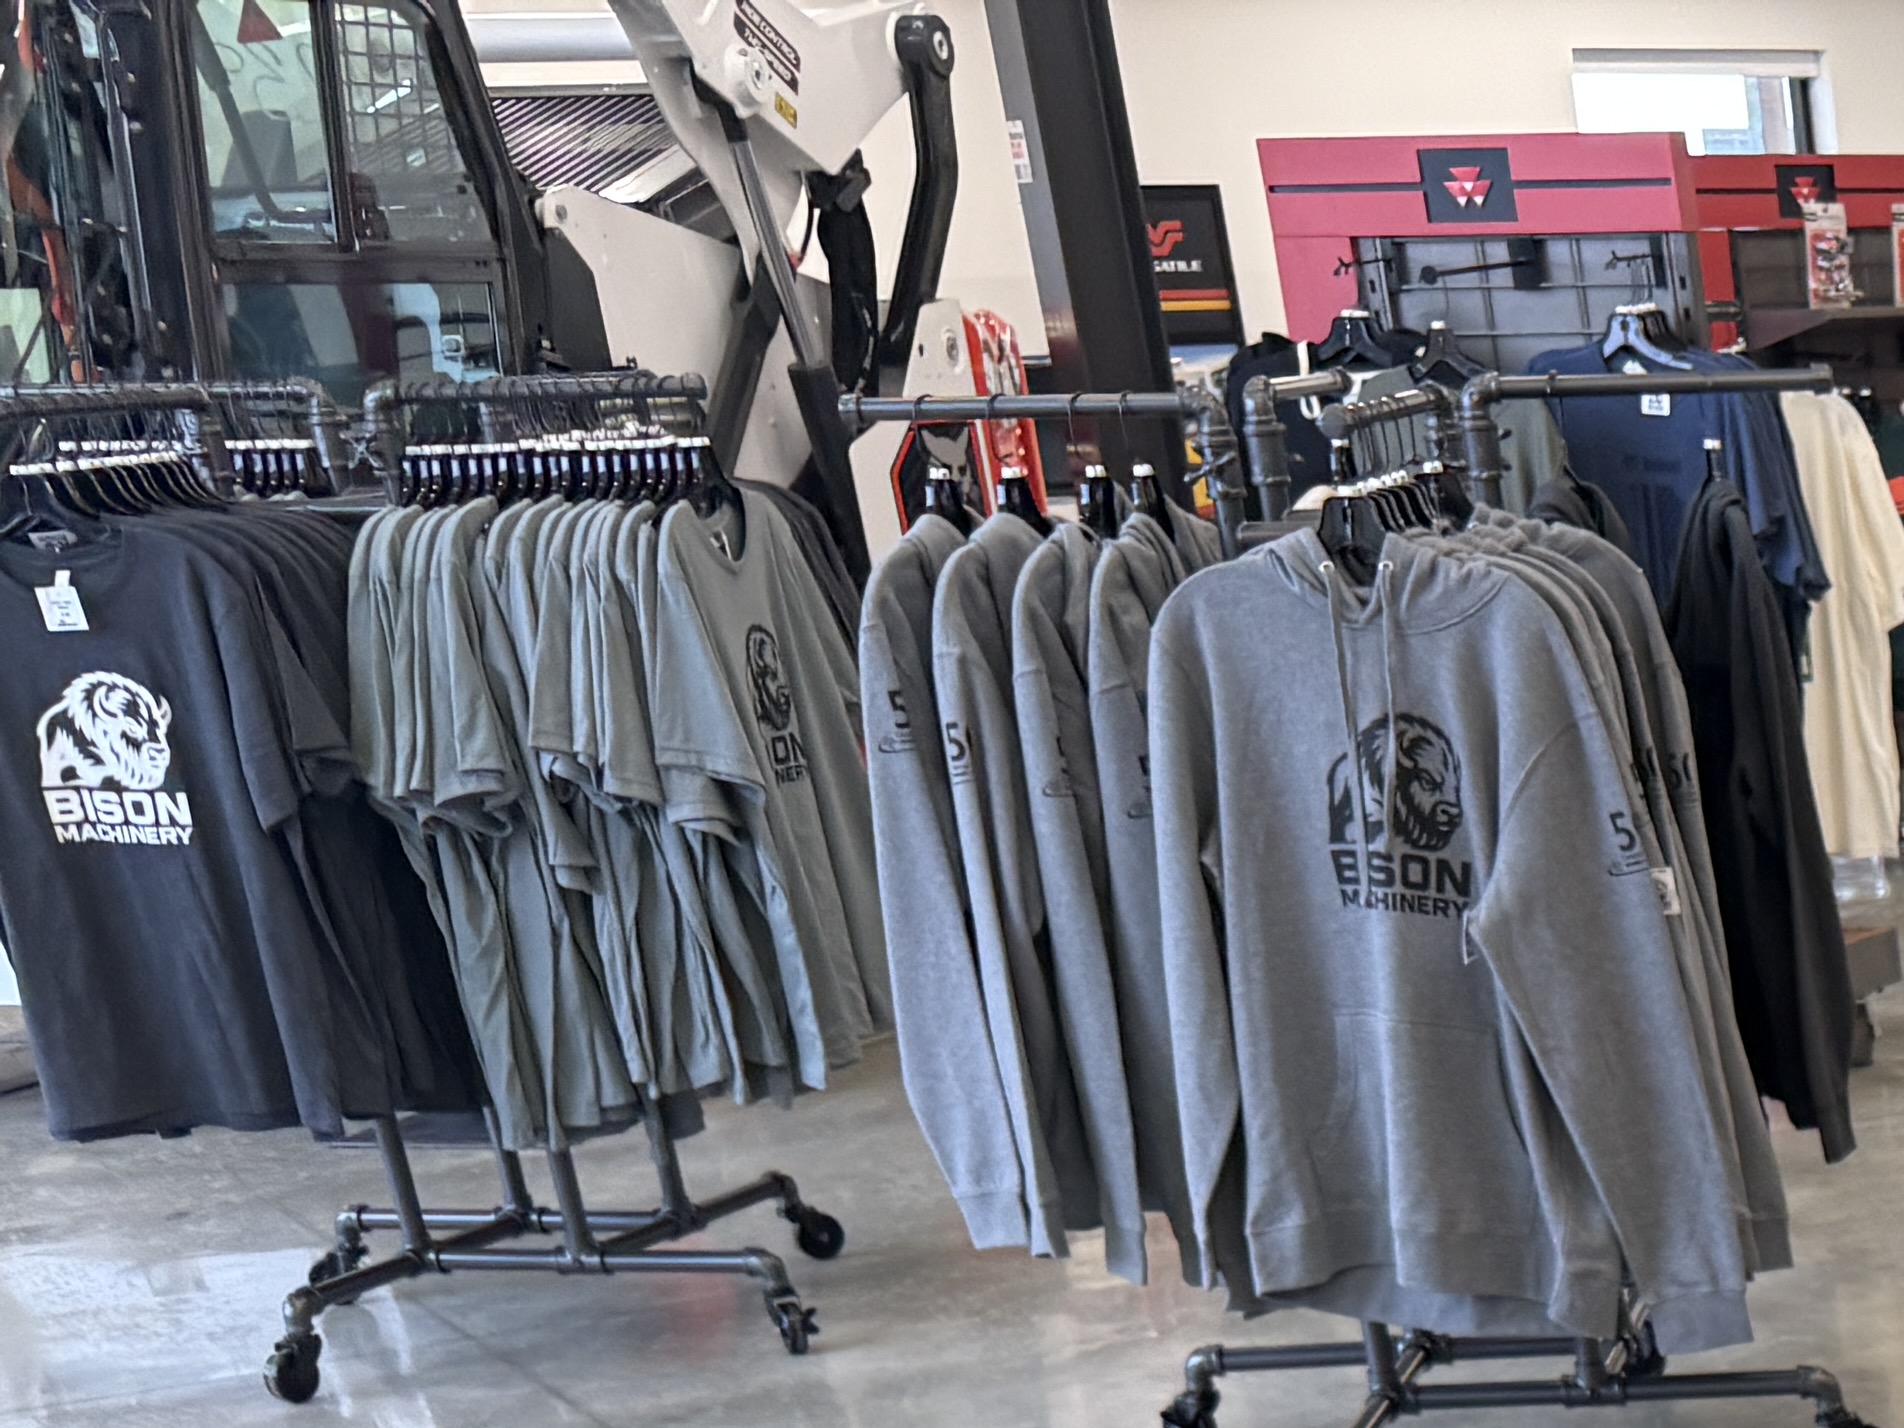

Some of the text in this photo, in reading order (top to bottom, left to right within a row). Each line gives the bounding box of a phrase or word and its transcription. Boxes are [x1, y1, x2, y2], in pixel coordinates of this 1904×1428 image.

[1153, 260, 1202, 272] SATILE
[41, 789, 193, 827] BISON
[53, 823, 194, 846] MACHINERY
[1330, 849, 1473, 899] BSON
[1340, 888, 1470, 919] MHINERY
